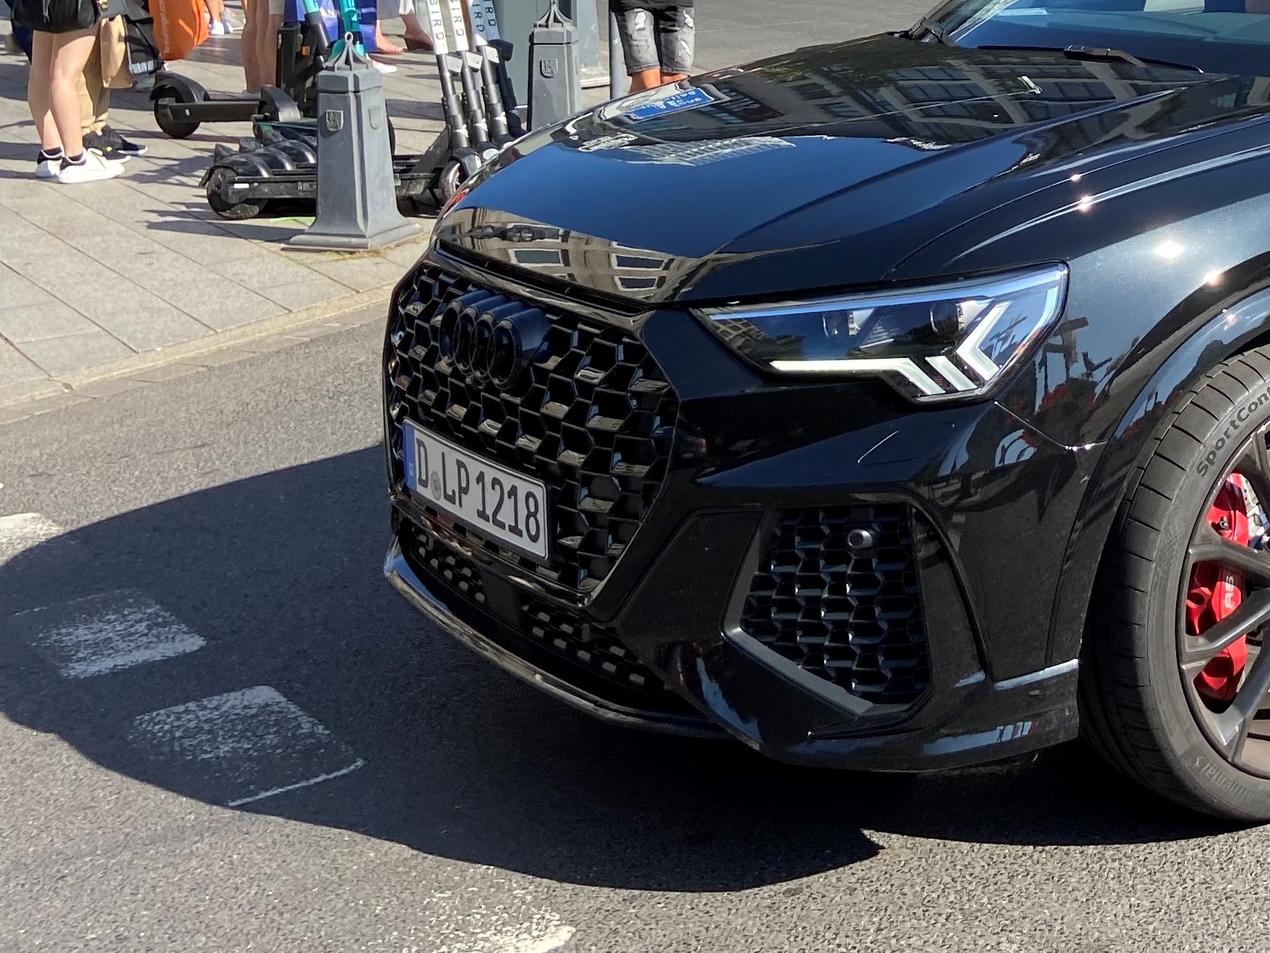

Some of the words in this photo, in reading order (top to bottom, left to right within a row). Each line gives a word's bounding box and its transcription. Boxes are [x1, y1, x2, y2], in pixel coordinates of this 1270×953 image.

[416, 438, 428, 489] D
[441, 451, 470, 508] LP
[475, 470, 540, 544] 1218
[1225, 575, 1235, 608] RS
